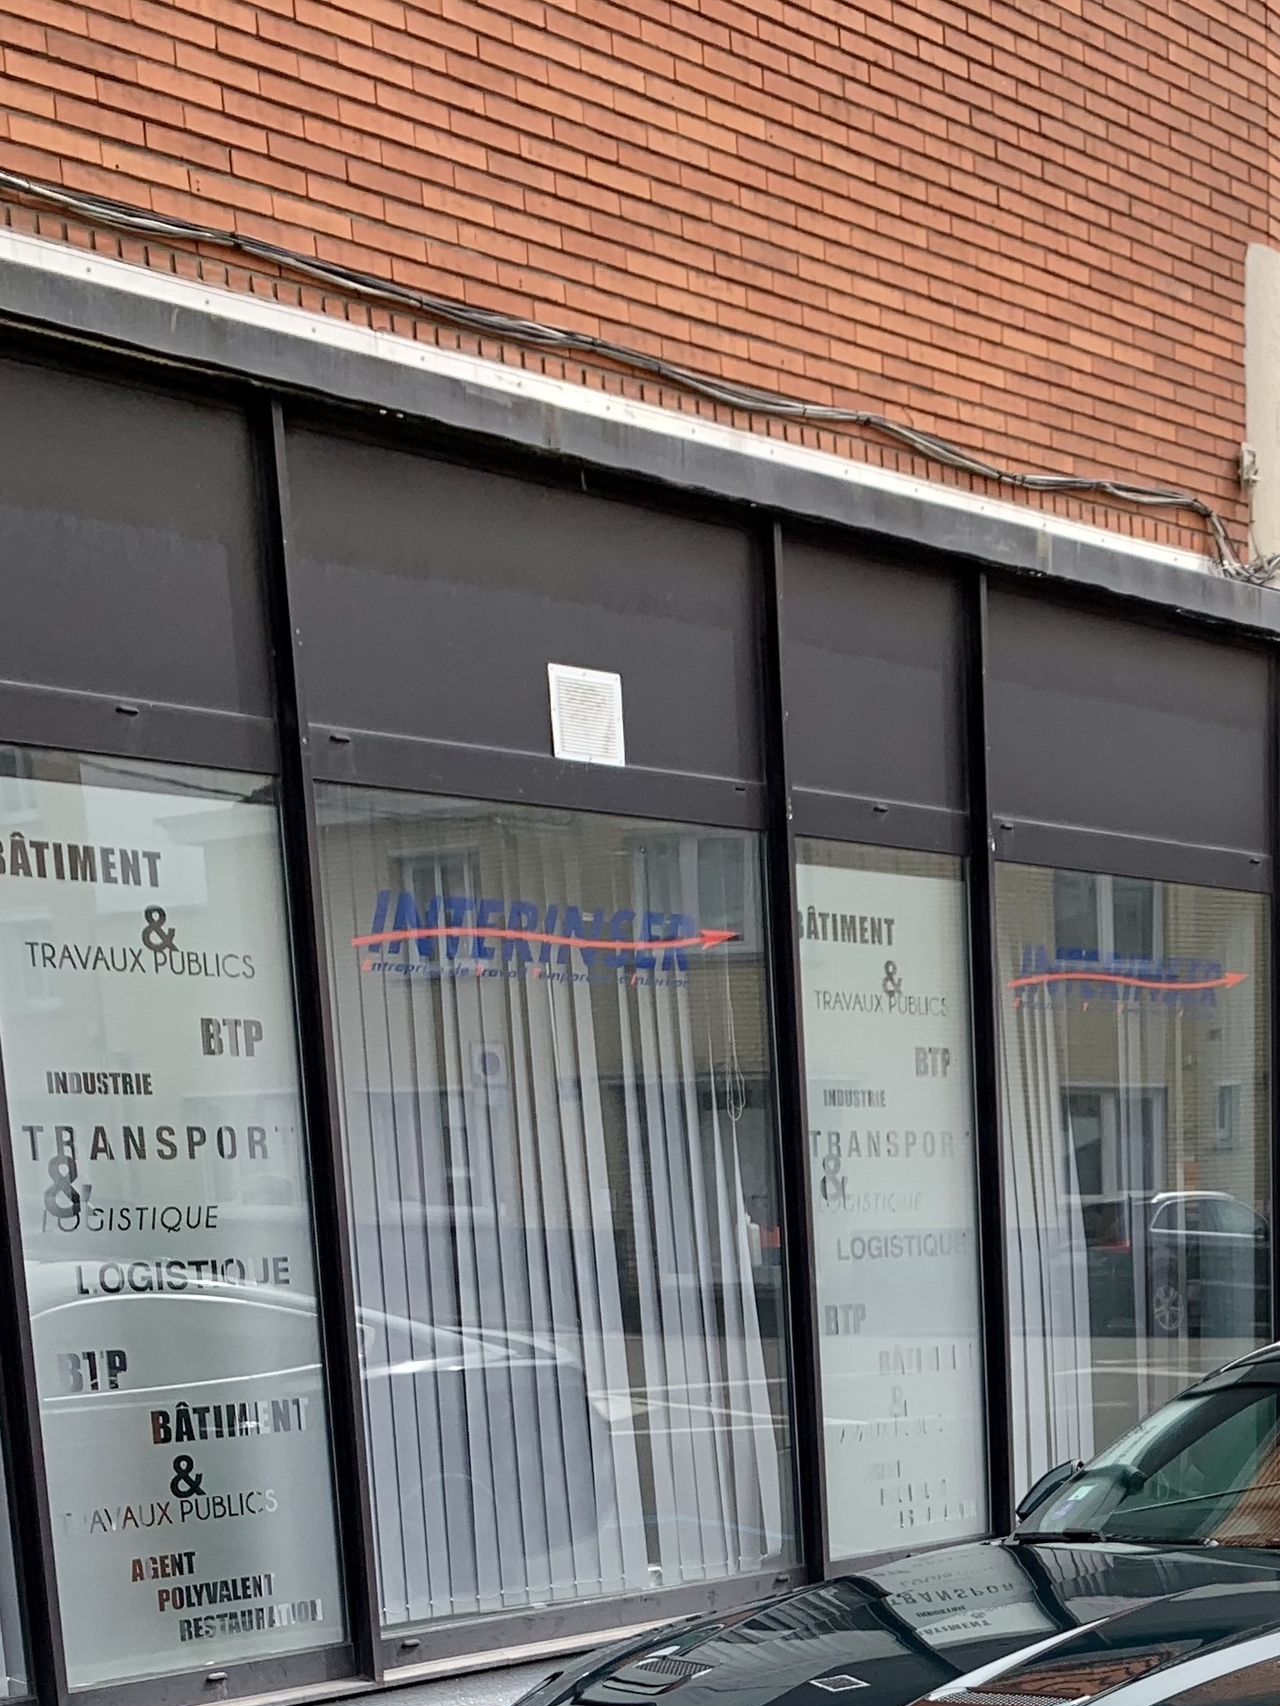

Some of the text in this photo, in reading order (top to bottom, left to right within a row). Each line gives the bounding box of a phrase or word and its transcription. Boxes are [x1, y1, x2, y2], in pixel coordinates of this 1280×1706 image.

[142, 905, 179, 952] &
[25, 941, 256, 979] TRAVAUX PUBLICS
[882, 960, 902, 998] &
[814, 990, 948, 1017] TRAVAUX PUBLICS
[201, 1017, 263, 1056] BTP
[914, 1047, 951, 1077] BTP
[46, 1070, 153, 1096] INDUSTRIE
[823, 1089, 886, 1108] INDUSTRIE
[22, 1125, 296, 1162] TRANSPOR
[809, 1130, 970, 1159] TRANSPOR
[44, 1155, 92, 1219] &
[42, 1205, 218, 1233] LOGISTIQUE
[76, 1256, 291, 1295] LOGISTIQUE
[824, 1303, 866, 1336] BTP
[57, 1349, 128, 1393] BTP
[151, 1398, 309, 1445] BÂTIMENT
[170, 1454, 206, 1498] &
[62, 1489, 278, 1537] TAVAUX PUBLICS
[131, 1551, 196, 1582] AGENT
[158, 1573, 276, 1612] POLYVALENT
[179, 1598, 324, 1642] RESTAURATION
